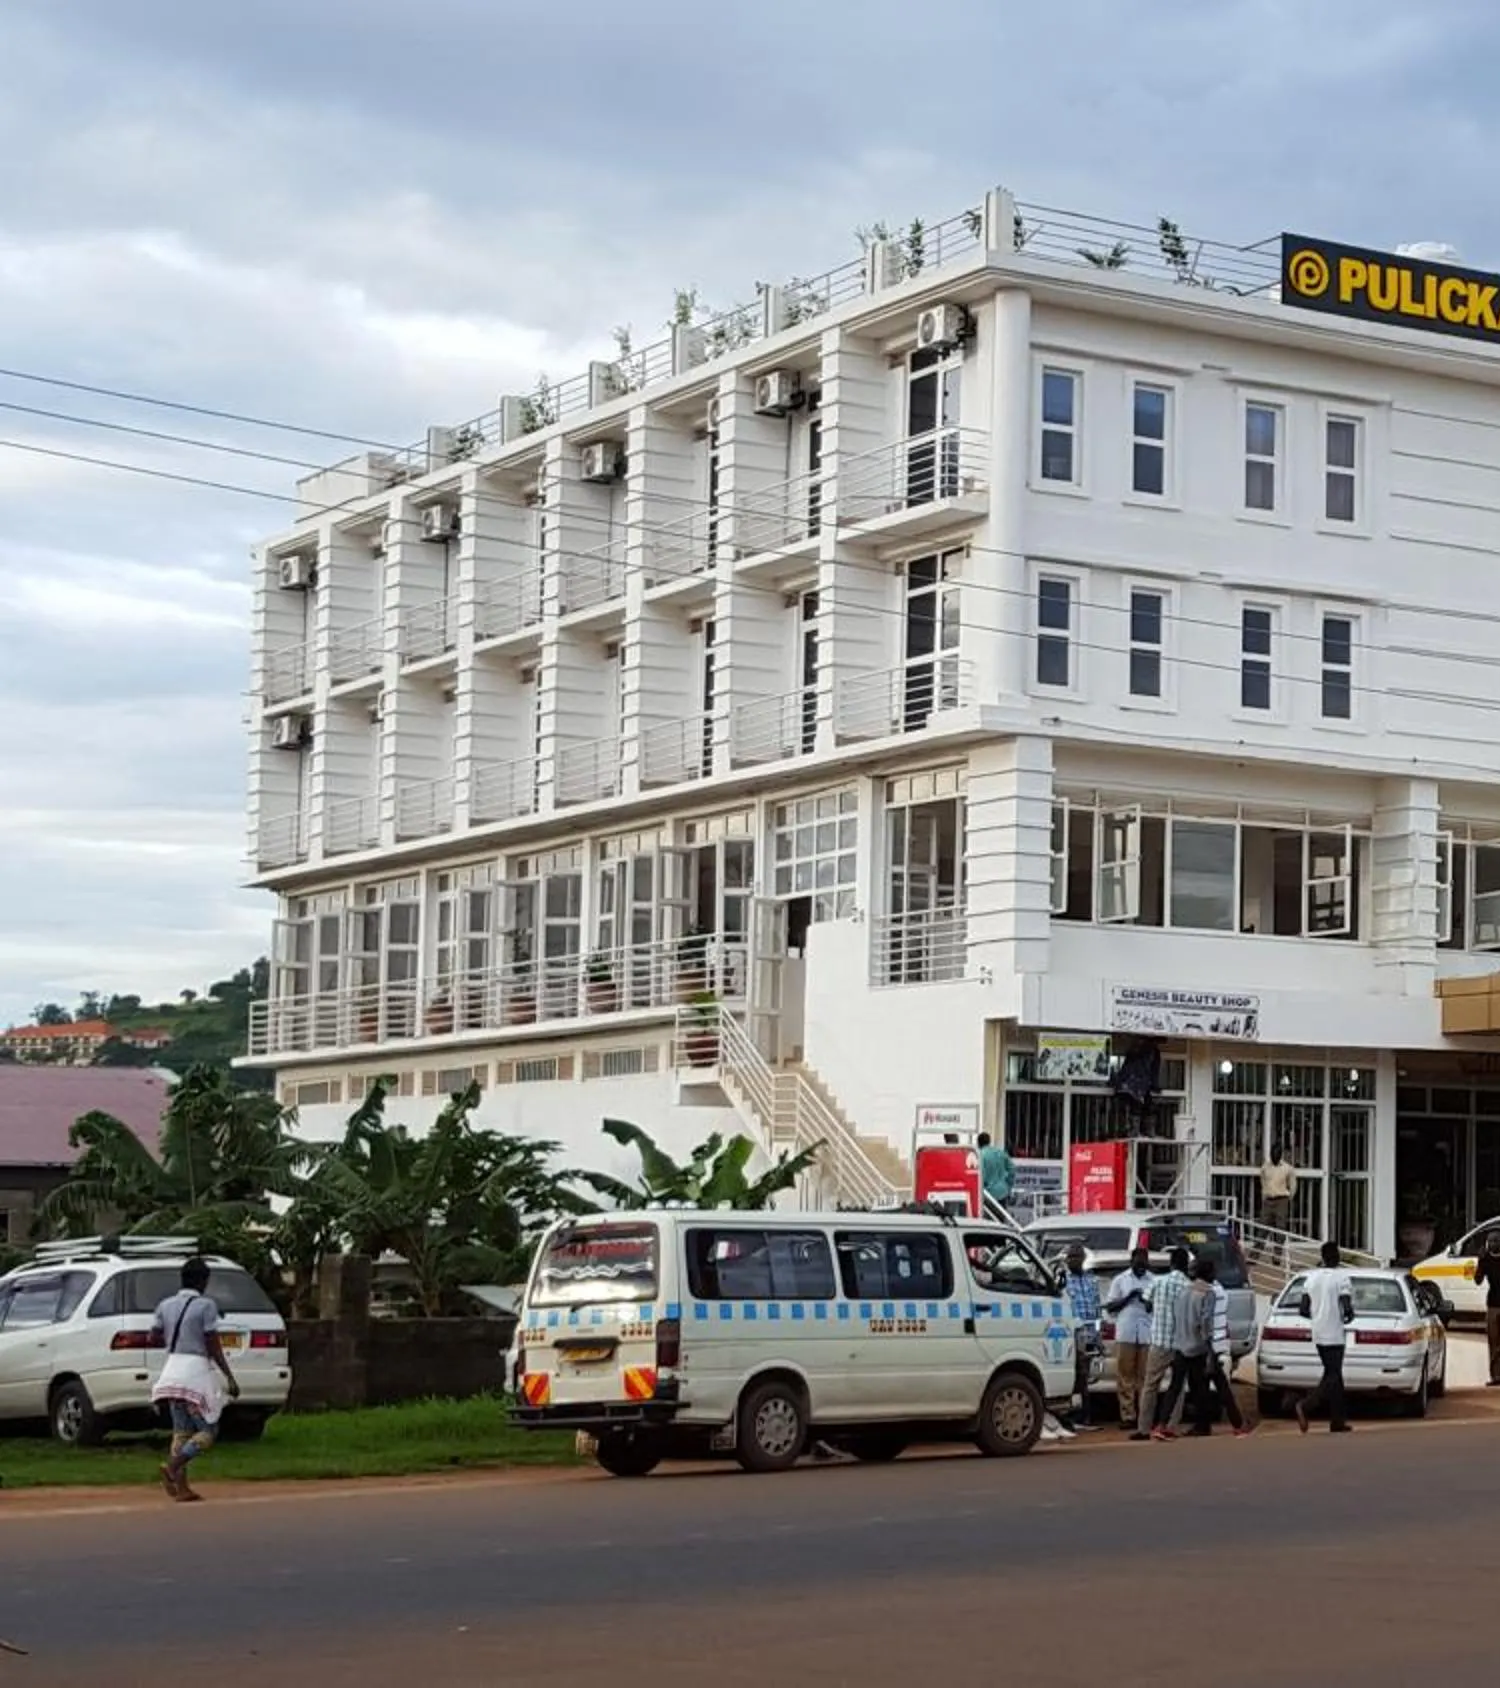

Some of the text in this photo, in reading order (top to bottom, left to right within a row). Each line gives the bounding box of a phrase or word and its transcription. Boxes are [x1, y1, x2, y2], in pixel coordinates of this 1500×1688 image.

[1121, 988, 1252, 1007] GENESIS BEAUTY SHOP
